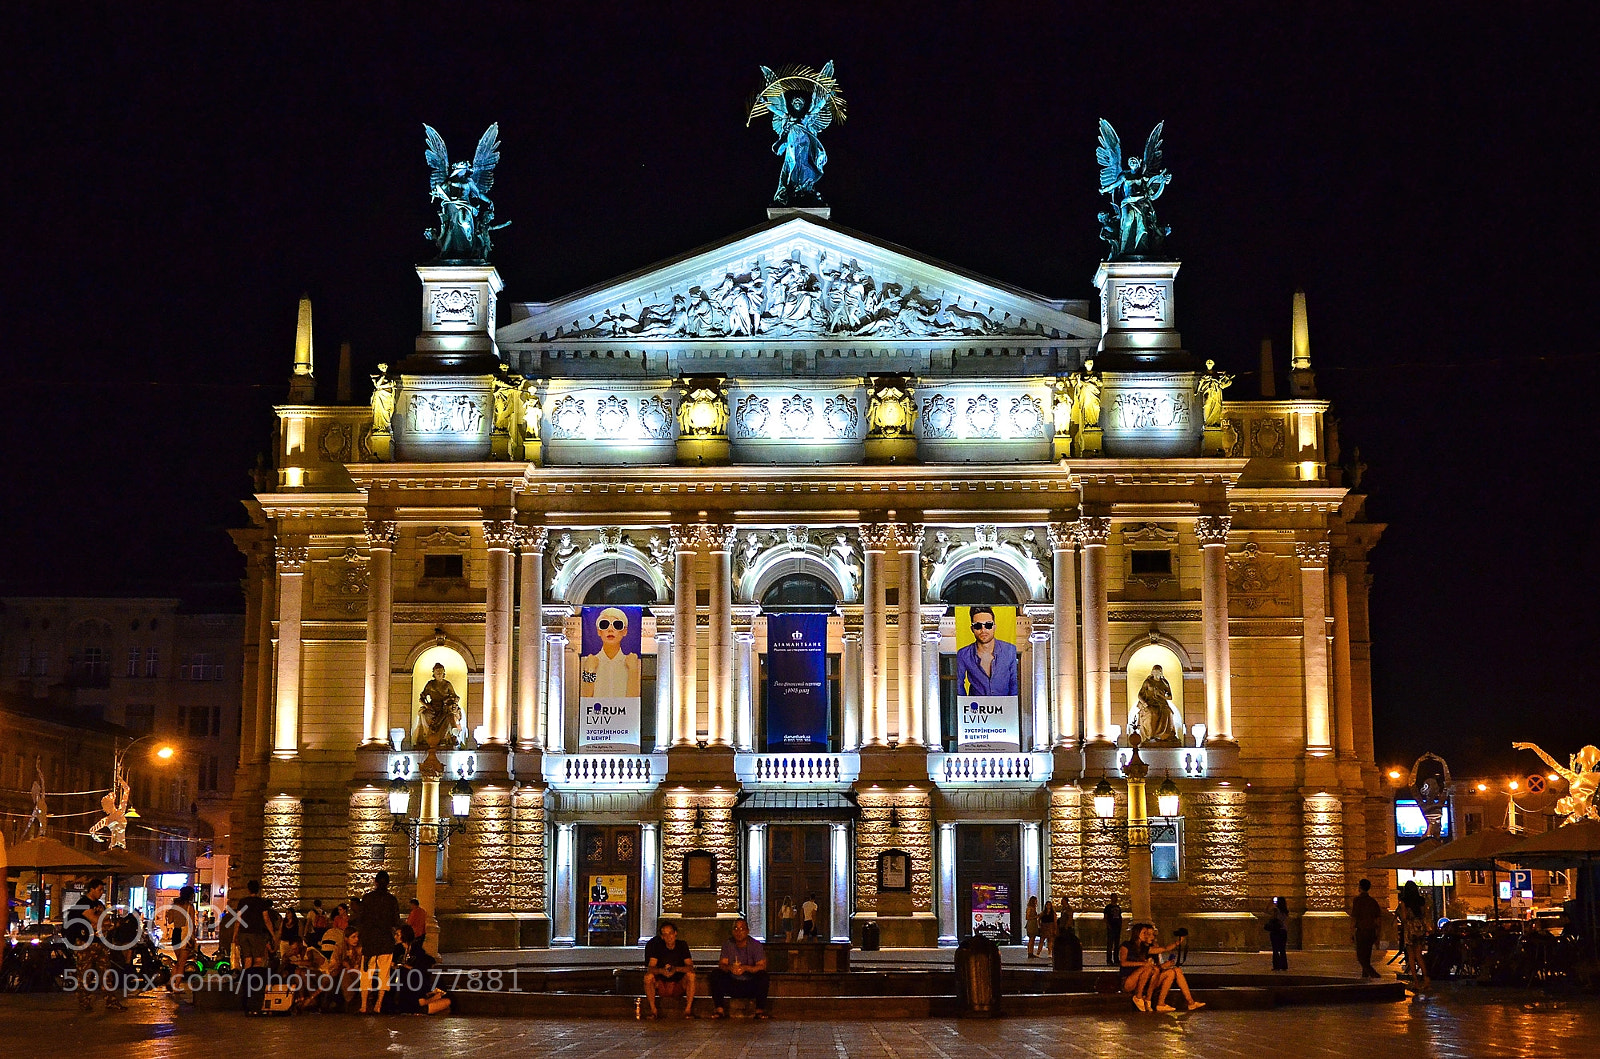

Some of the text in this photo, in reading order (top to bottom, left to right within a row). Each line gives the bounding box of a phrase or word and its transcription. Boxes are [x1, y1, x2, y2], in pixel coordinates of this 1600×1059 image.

[586, 716, 611, 724] LVIV
[964, 715, 988, 723] LVIV
[1515, 872, 1526, 888] P
